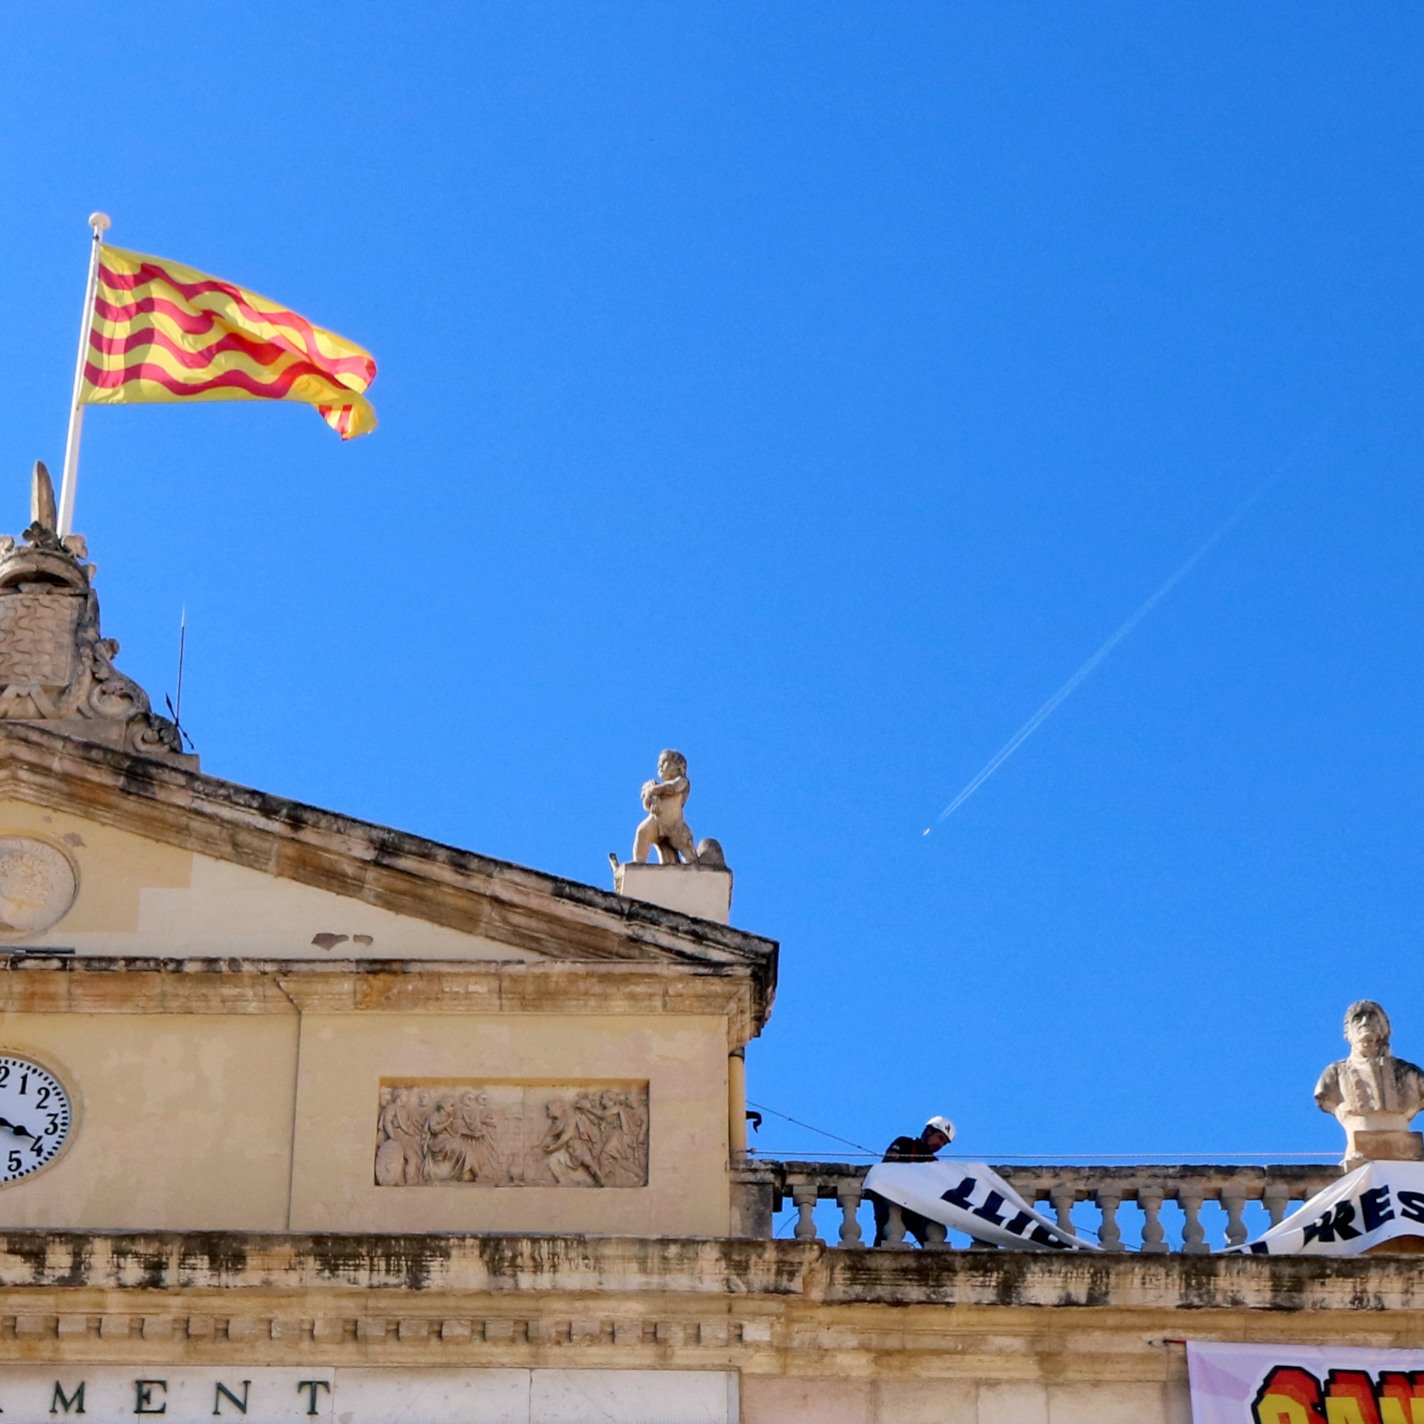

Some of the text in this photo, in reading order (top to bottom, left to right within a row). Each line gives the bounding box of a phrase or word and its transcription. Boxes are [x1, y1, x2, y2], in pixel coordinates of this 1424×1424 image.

[19, 1073, 28, 1095] 1
[35, 1087, 50, 1109] 2
[44, 1113, 60, 1135] 3
[30, 1135, 43, 1157] 4
[8, 1150, 22, 1172] 5
